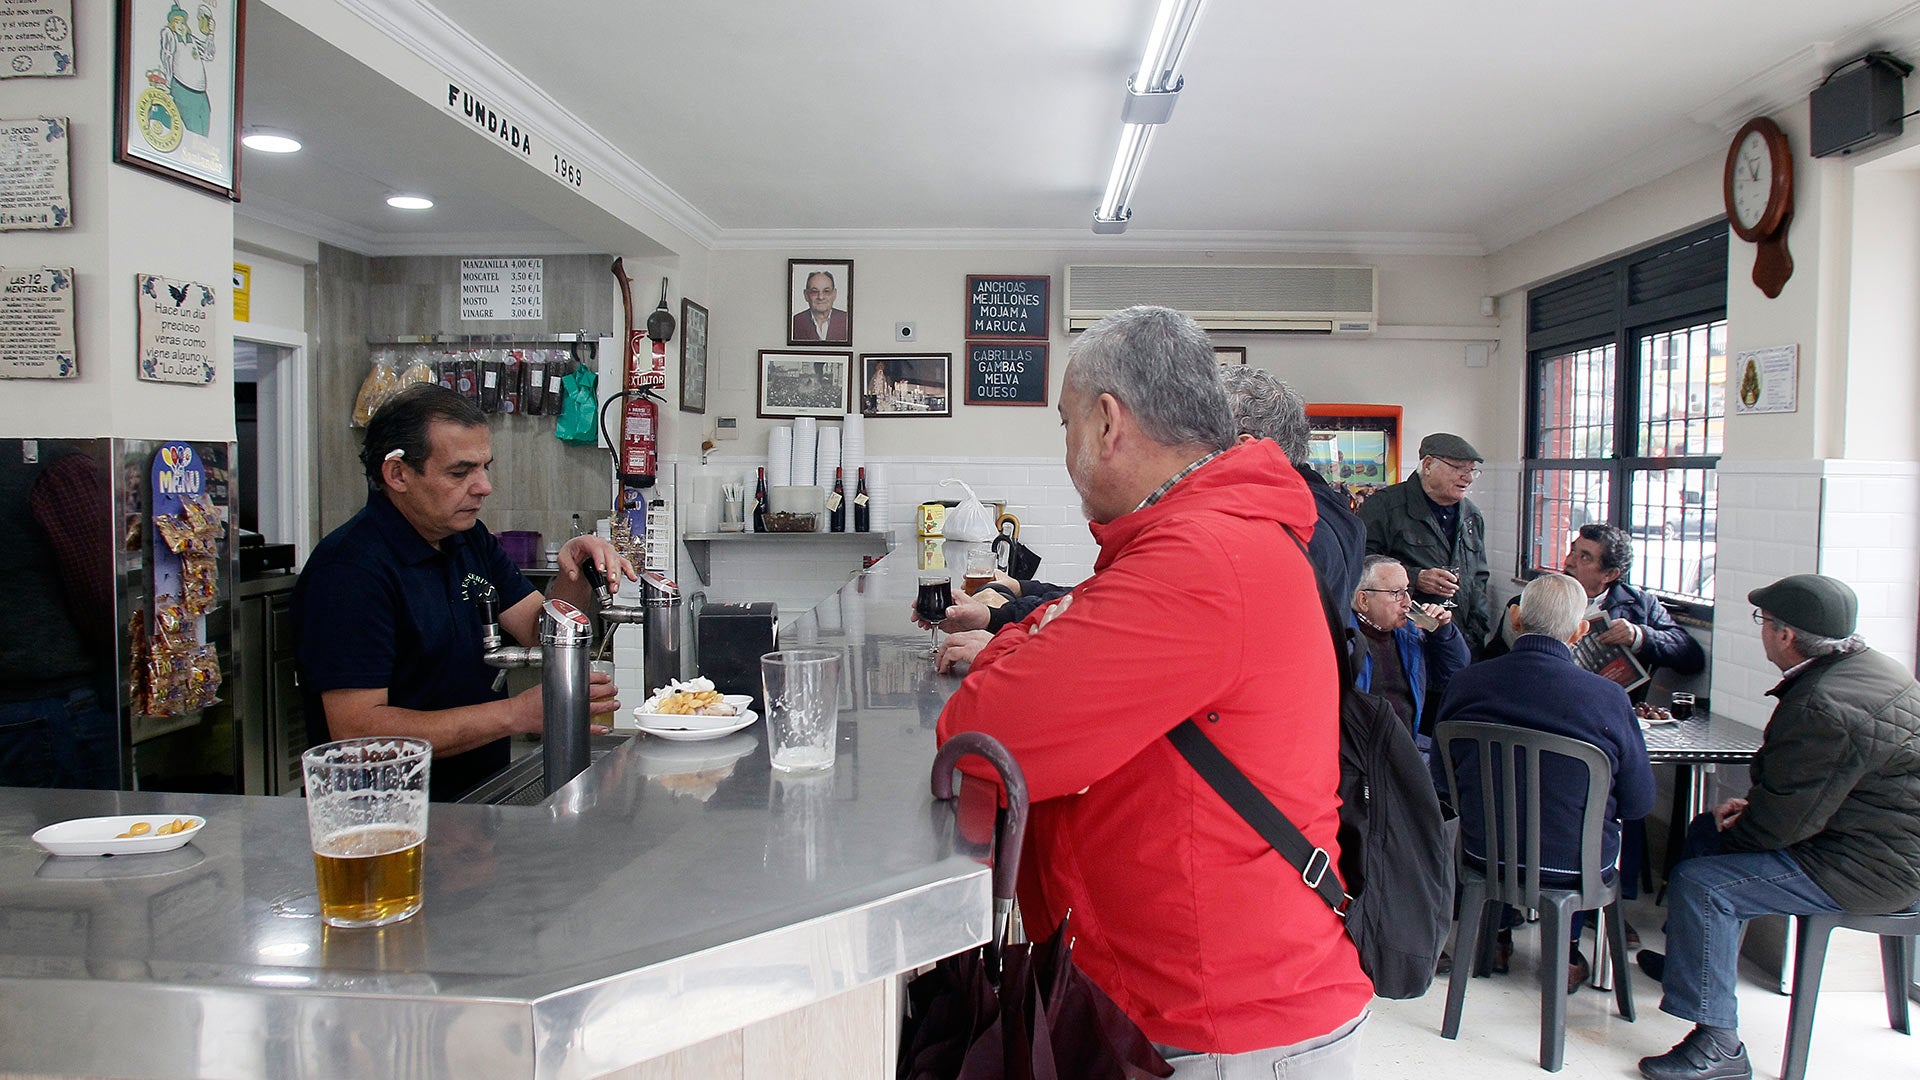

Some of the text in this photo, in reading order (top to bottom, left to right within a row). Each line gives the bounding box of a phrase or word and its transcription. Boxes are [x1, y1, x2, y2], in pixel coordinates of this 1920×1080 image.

[449, 84, 582, 186] FUNDADA 1969
[463, 261, 508, 269] MANZANILLA
[511, 261, 526, 269] 4,00
[28, 274, 42, 284] 12
[463, 273, 499, 281] MOSCATEL
[511, 273, 526, 281] 3,50
[5, 285, 49, 293] MENTIRAS
[463, 285, 499, 293] MONTILLA
[511, 285, 526, 293] 2,50
[977, 281, 1026, 293] ANCHOAS
[463, 297, 488, 305] MOSTO
[511, 297, 526, 305] 2,50
[973, 293, 1040, 306] MEJILLONES
[155, 302, 178, 316] Hace
[180, 309, 191, 318] un
[463, 309, 493, 317] VINAGRE
[511, 309, 526, 317] 3,00
[980, 306, 1028, 318] MOJAMA
[161, 320, 200, 333] precioso
[975, 320, 1026, 332] MARUCA
[155, 335, 206, 348] veras como
[146, 347, 170, 359] viene
[172, 349, 201, 363] alguno
[973, 349, 1032, 361] CABRILLAS
[978, 361, 1024, 373] GAMBAS
[984, 373, 1019, 385] MELVA
[977, 385, 1017, 398] QUESO
